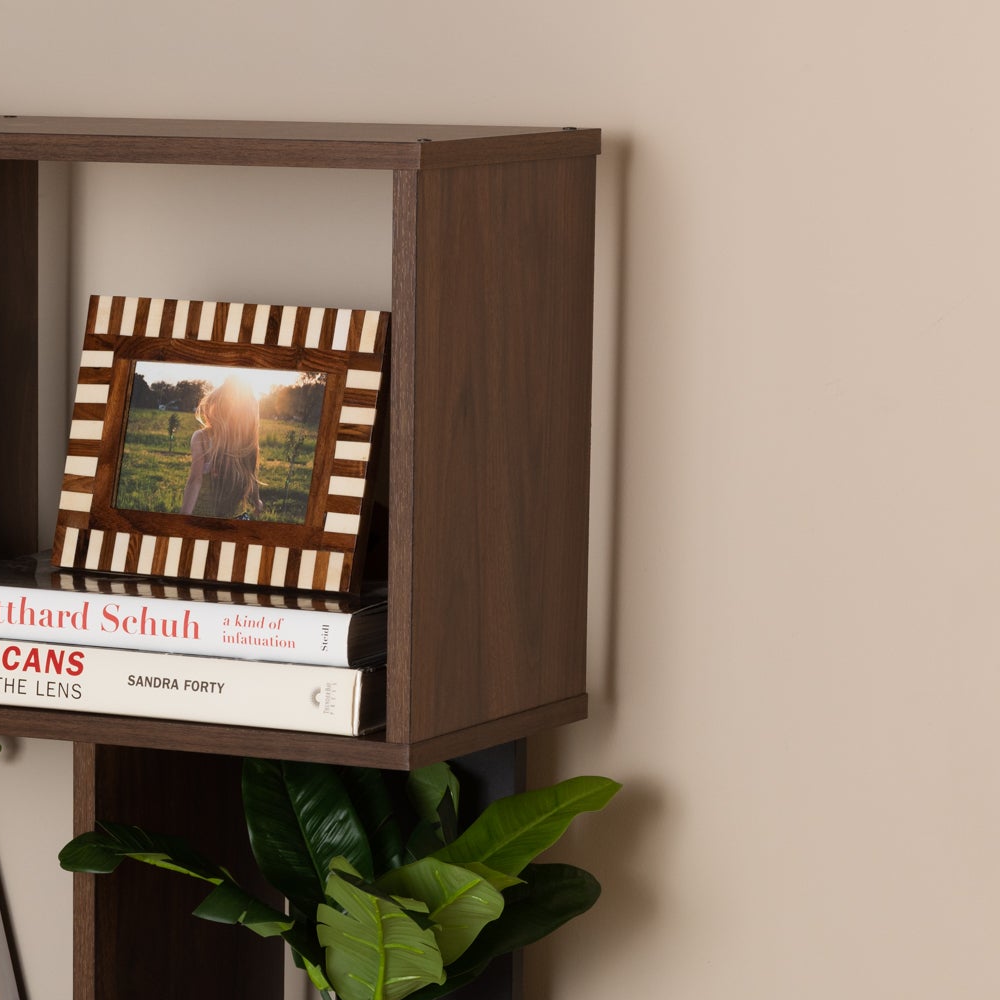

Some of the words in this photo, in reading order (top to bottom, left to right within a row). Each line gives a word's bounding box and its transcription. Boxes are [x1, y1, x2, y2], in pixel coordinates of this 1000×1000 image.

[101, 603, 201, 640] Schuh
[223, 617, 231, 627] a
[235, 614, 265, 629] kind
[268, 617, 285, 631] of
[222, 631, 296, 649] infatuation
[321, 624, 330, 652] Steidl
[36, 681, 82, 700] LENS
[128, 675, 179, 690] SANDRA
[184, 680, 225, 694] FORTY
